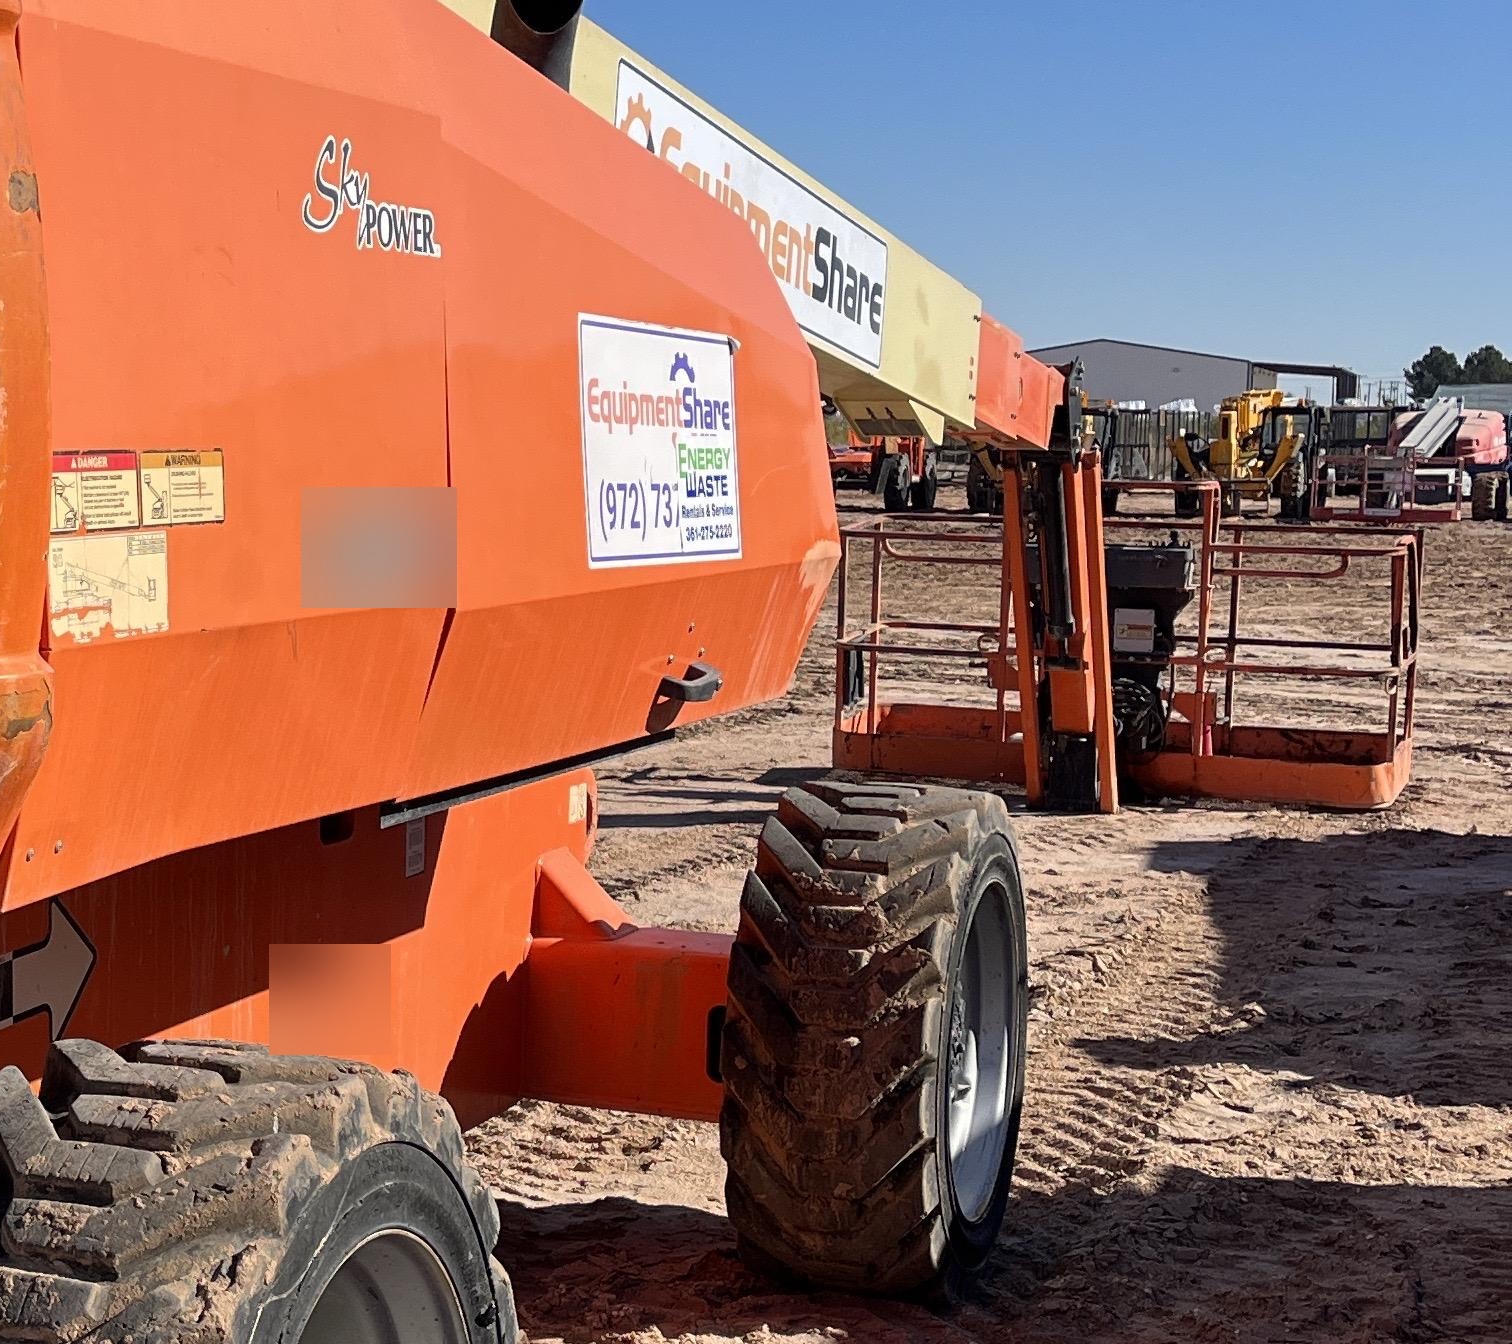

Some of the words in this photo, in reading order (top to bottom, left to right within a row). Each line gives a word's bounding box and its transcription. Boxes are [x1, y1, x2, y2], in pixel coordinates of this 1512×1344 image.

[303, 139, 369, 247] Sky
[365, 203, 436, 255] POWER
[659, 126, 883, 336] mentShare
[588, 378, 731, 435] EquipmentShare
[77, 456, 109, 468] DANGER
[678, 443, 731, 479] ENERGY
[686, 471, 729, 499] WASTE
[599, 478, 648, 543] (972)
[681, 504, 705, 519] Rentals
[705, 503, 712, 518] &
[712, 502, 734, 518] Service
